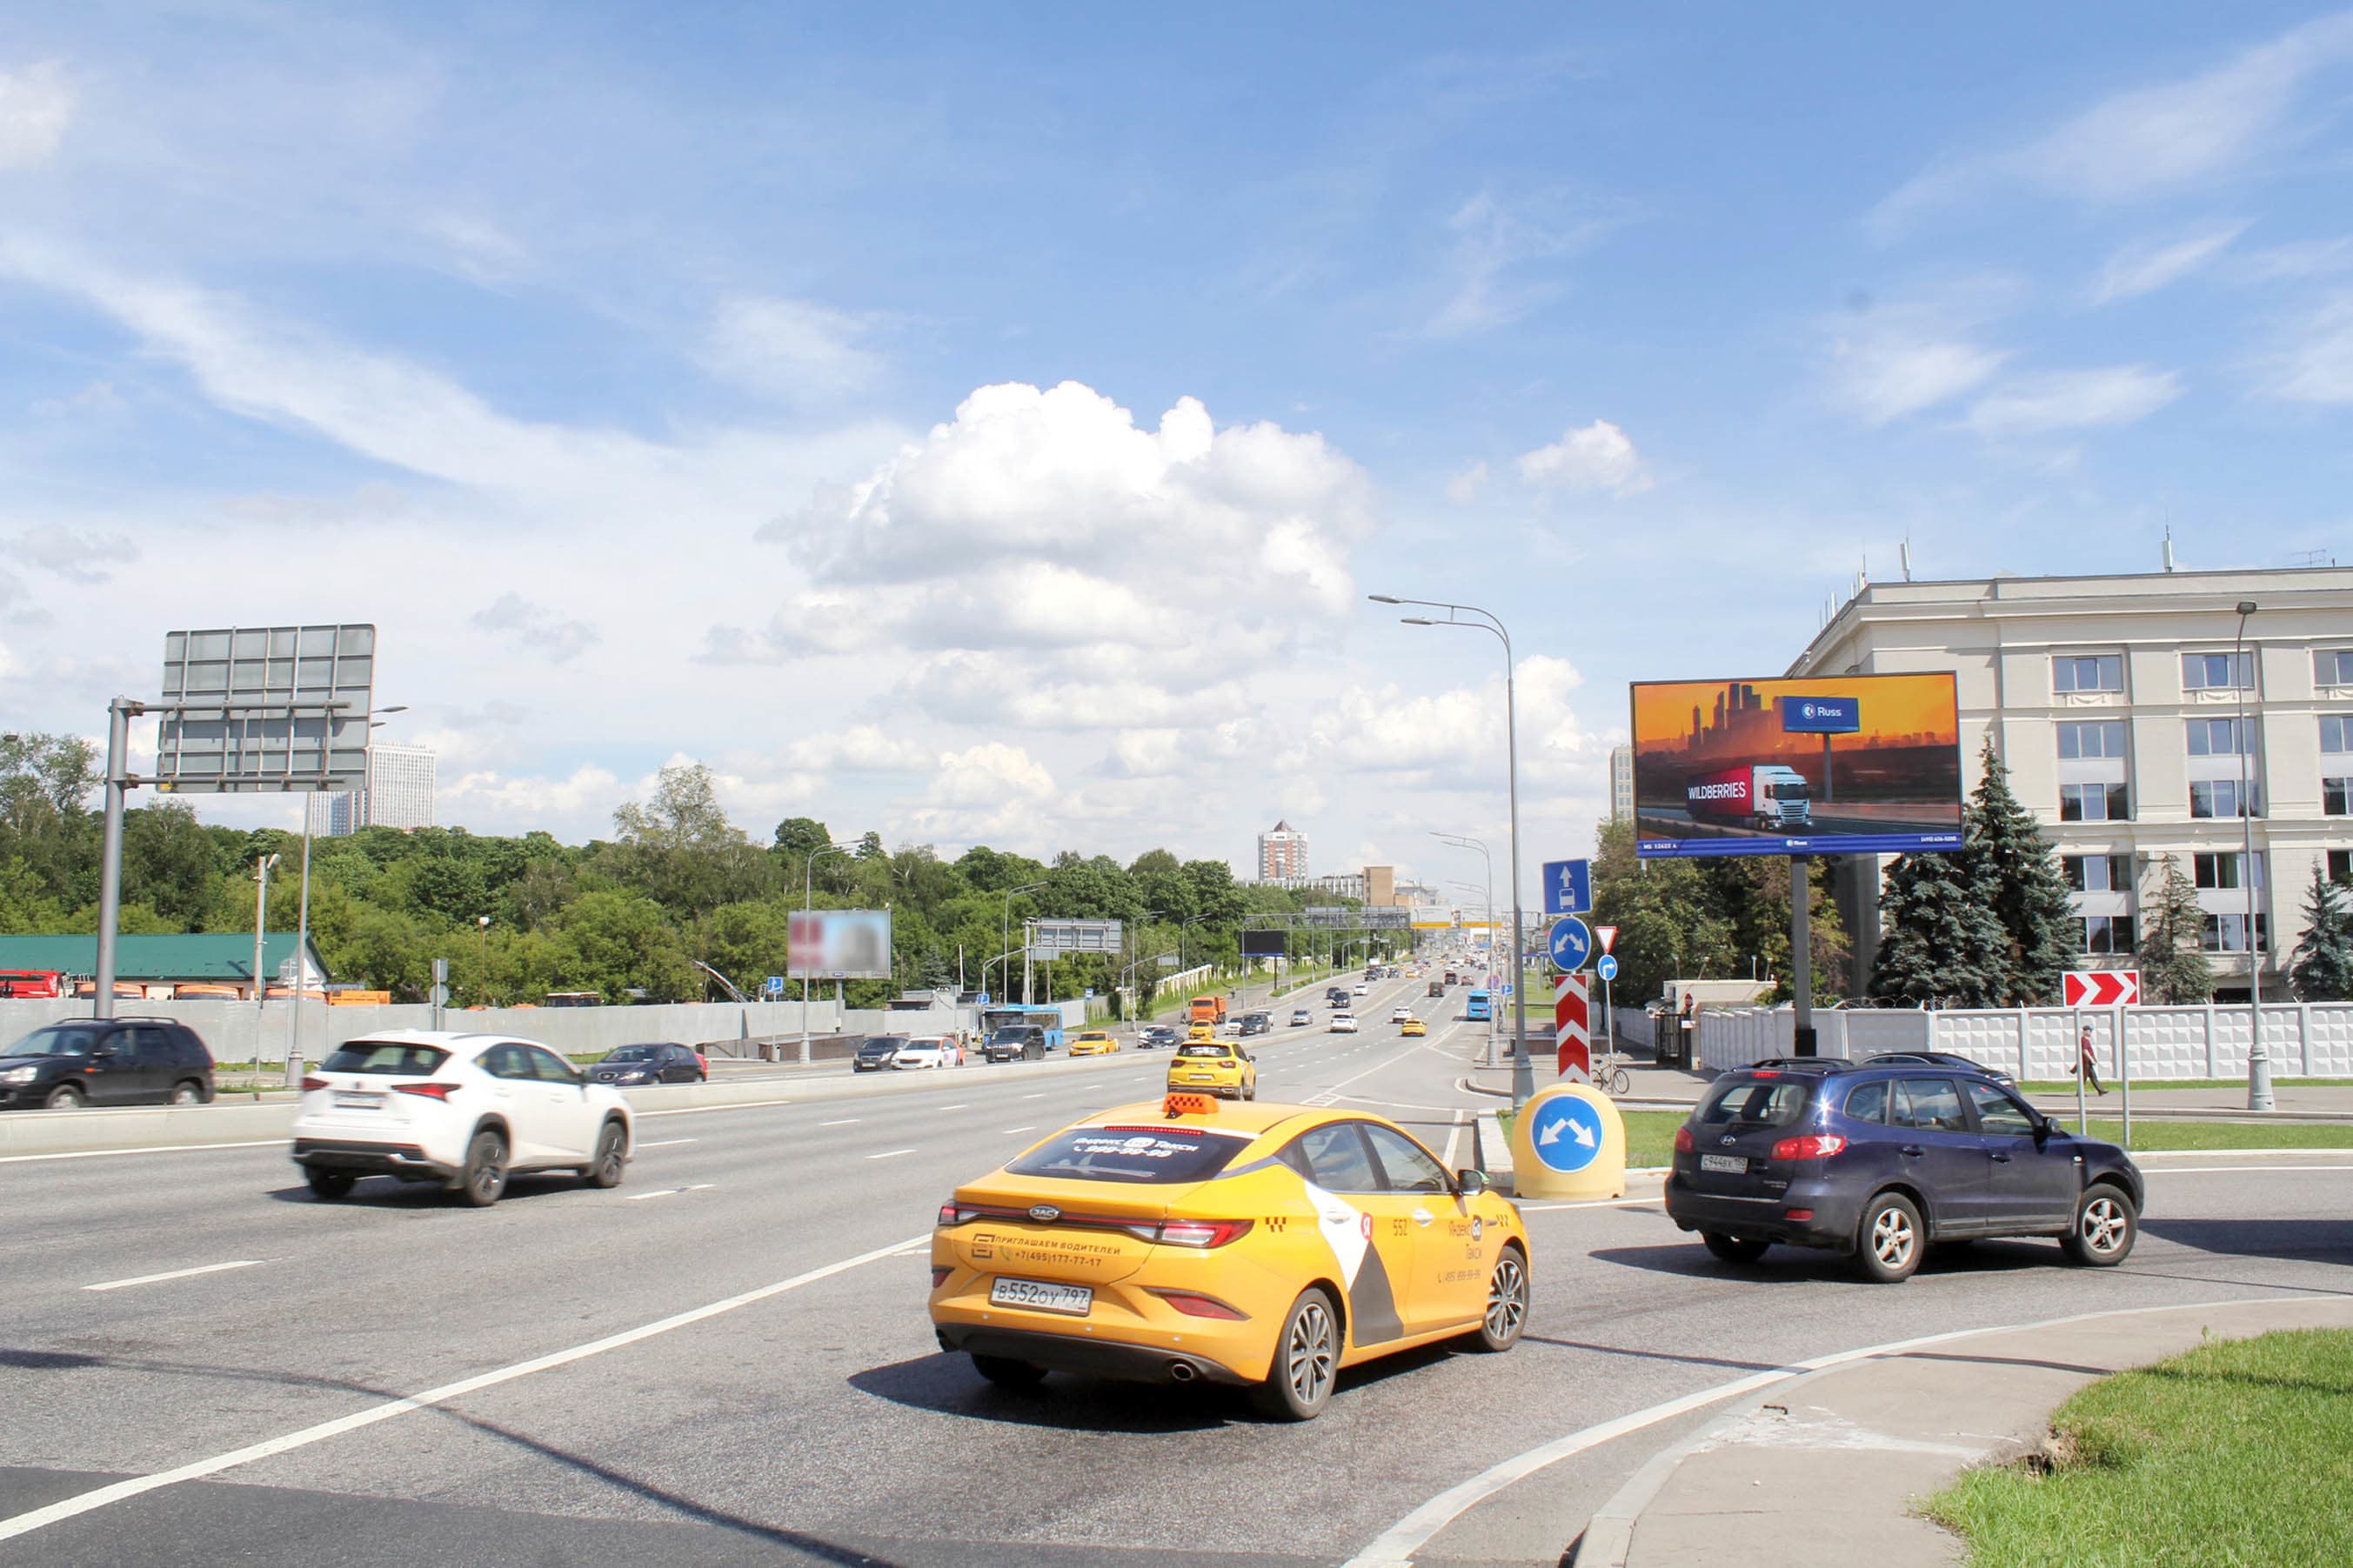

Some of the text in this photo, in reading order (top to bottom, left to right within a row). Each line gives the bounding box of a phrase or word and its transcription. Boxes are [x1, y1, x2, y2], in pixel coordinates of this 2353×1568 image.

[1817, 706, 1842, 717] Russ
[1688, 781, 1747, 800] WILDBERRIES
[1392, 1219, 1408, 1237] 552
[994, 1236, 1121, 1256] ПРИГЛАШАЕМ ВОДИТЕЛЕЙ
